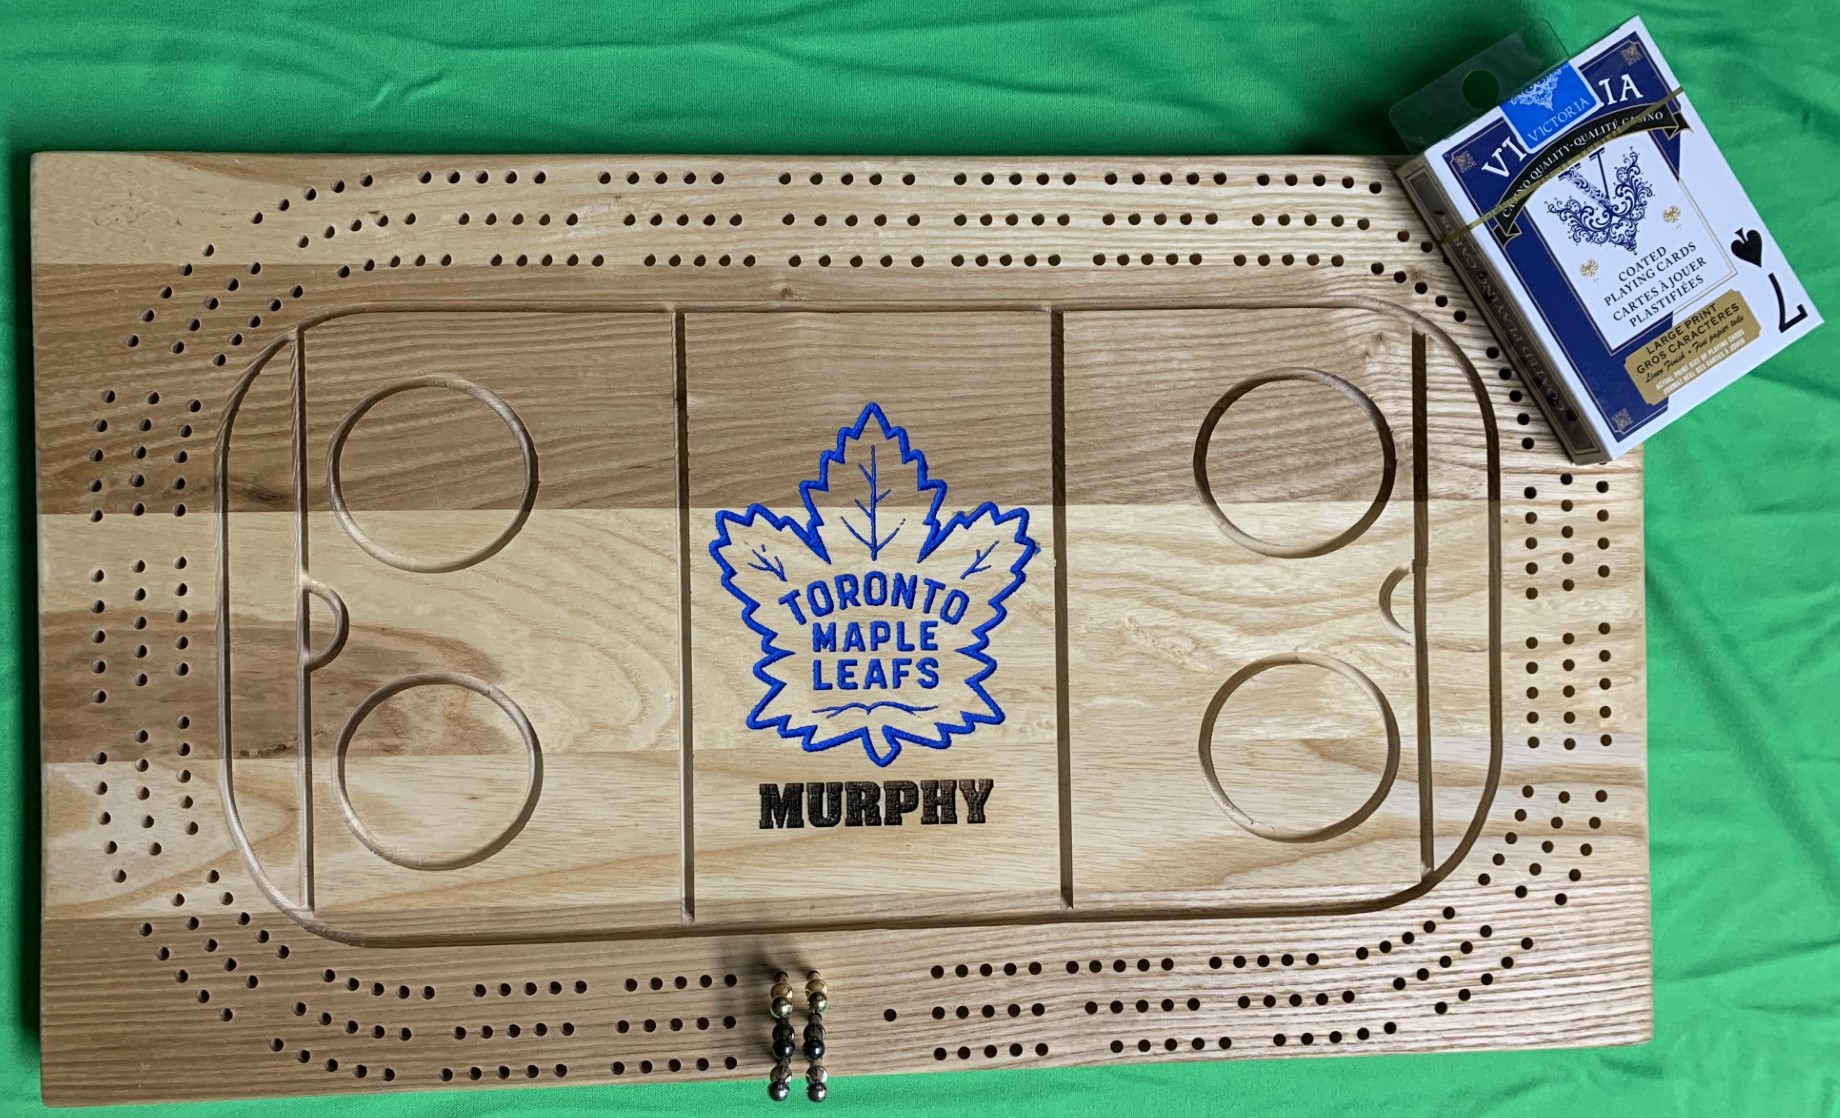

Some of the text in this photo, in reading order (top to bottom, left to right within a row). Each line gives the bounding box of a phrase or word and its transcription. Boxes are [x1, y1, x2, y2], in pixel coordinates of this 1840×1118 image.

[1528, 97, 1590, 142] VICTORIA
[1604, 241, 1697, 306] PLAYING CARDS
[1613, 257, 1707, 321] CARTES À JOUER
[1618, 246, 1667, 282] COATED
[1629, 274, 1705, 328] PLASTIFIÉES
[1768, 272, 1808, 333] 7
[1646, 303, 1718, 354] LARGE PRINT
[1636, 350, 1667, 374] GROS
[778, 570, 970, 625] TORONTO
[812, 620, 939, 653] MAPLE
[812, 657, 939, 690] LEAFS
[759, 779, 994, 829] MURPHY
